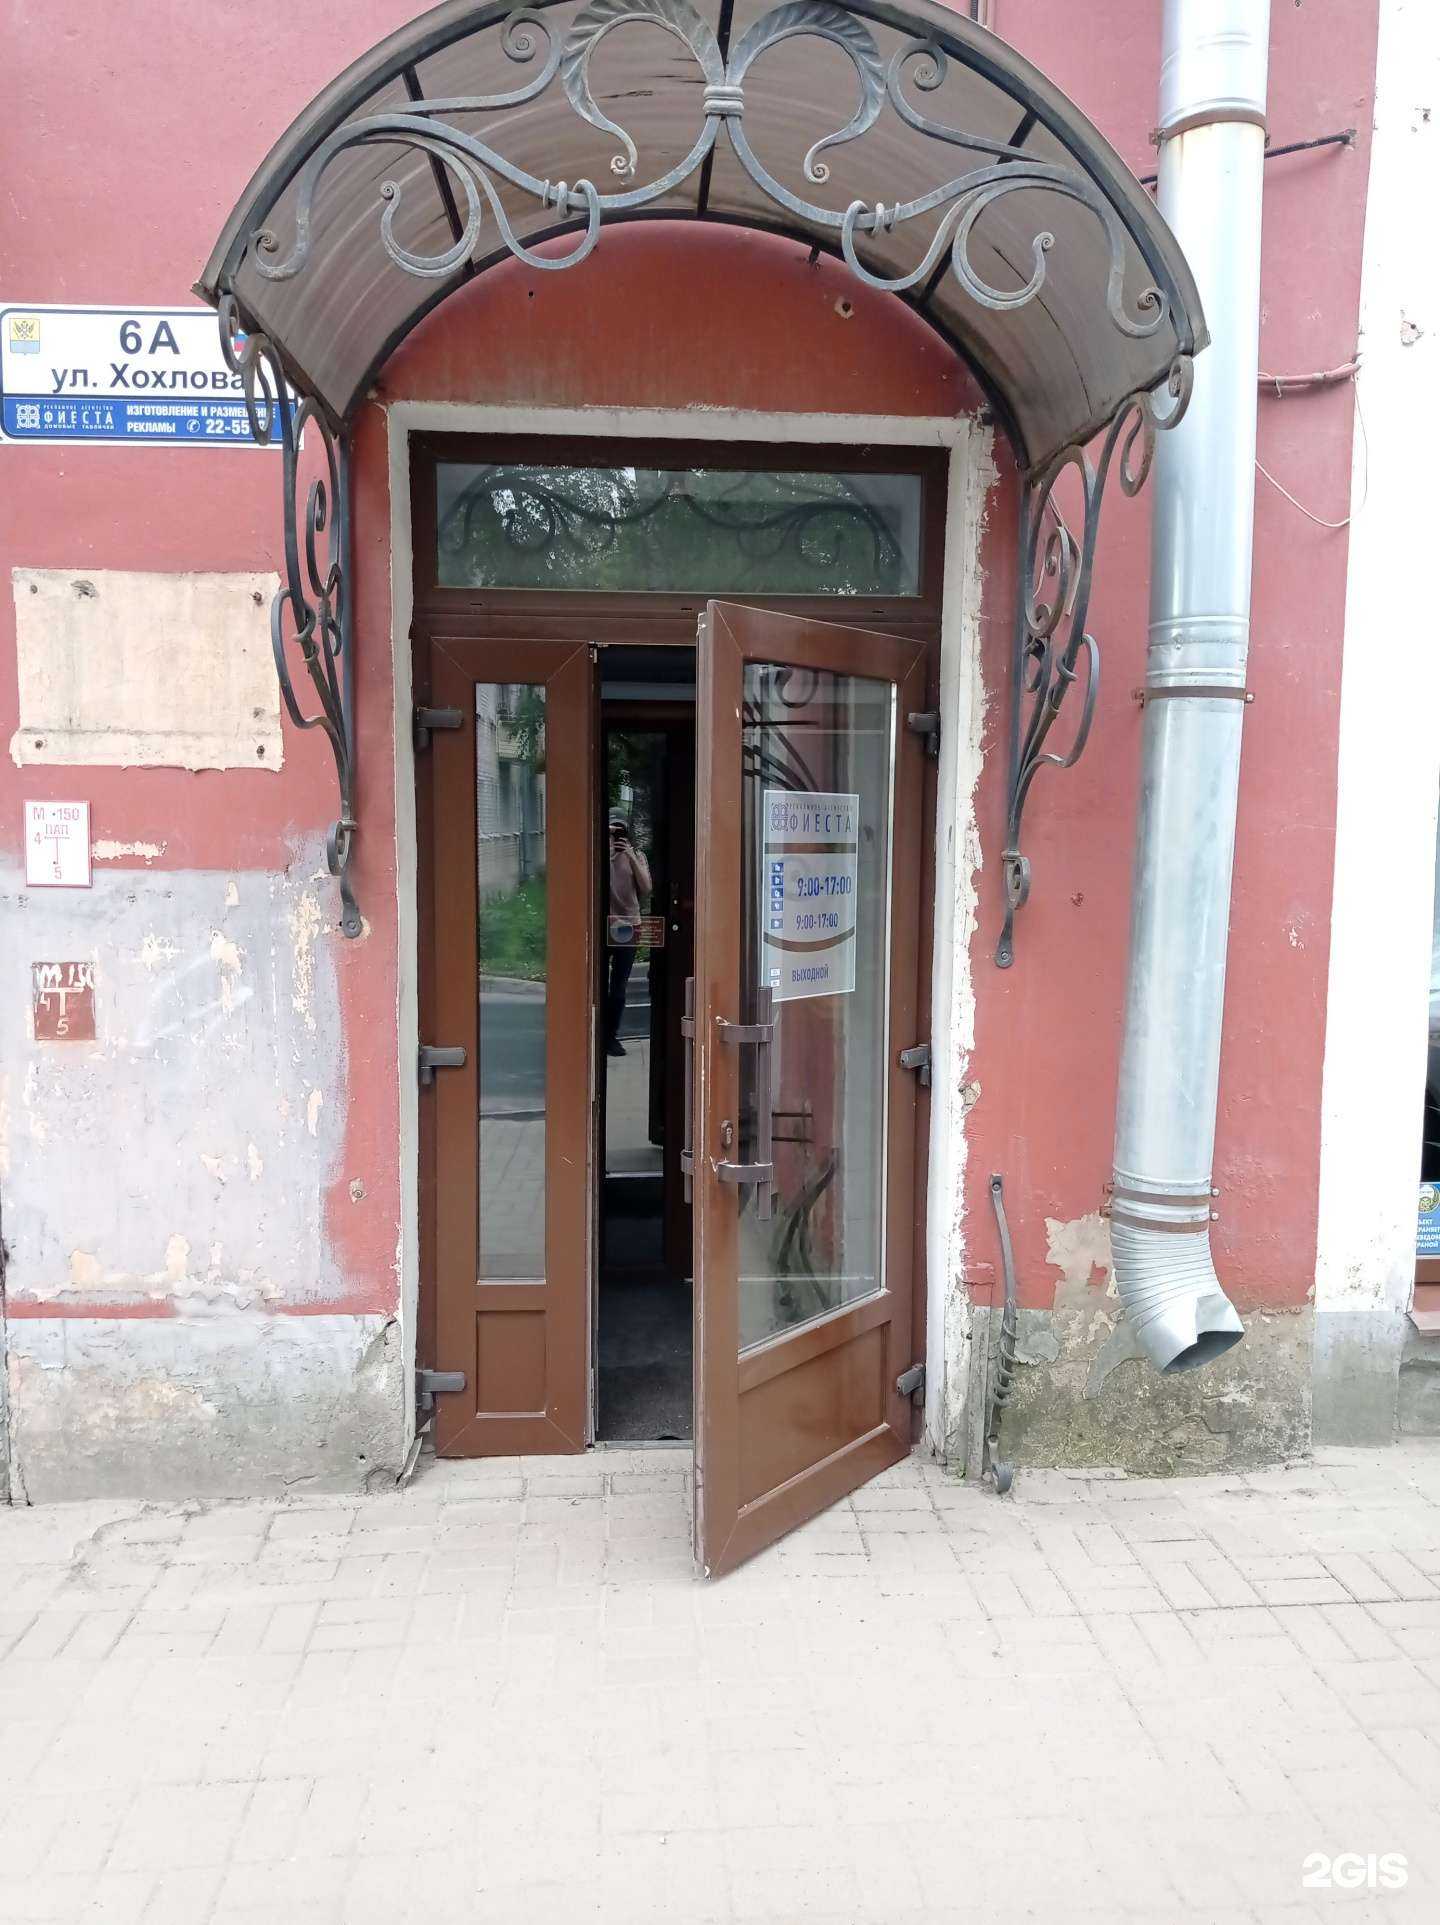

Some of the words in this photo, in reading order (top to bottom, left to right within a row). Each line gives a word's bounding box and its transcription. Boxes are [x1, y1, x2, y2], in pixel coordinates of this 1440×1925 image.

[119, 319, 181, 355] 6А
[51, 367, 98, 393] ул.
[109, 362, 247, 391] Хохлова
[43, 411, 114, 425] ФИЕСТА
[126, 405, 199, 417] ИЗГОТОВЛЕНИЕ
[201, 406, 208, 417] И
[126, 422, 176, 433] РЕКЛАМЫ
[57, 808, 80, 821] 150
[789, 813, 852, 833] ФИЕСТА
[54, 867, 62, 880] 5
[797, 876, 852, 897] 9:00-17:00
[796, 913, 840, 930] 9:00-17:00
[791, 964, 830, 982] ВЫХОДНОЙ
[56, 1018, 71, 1035] 5
